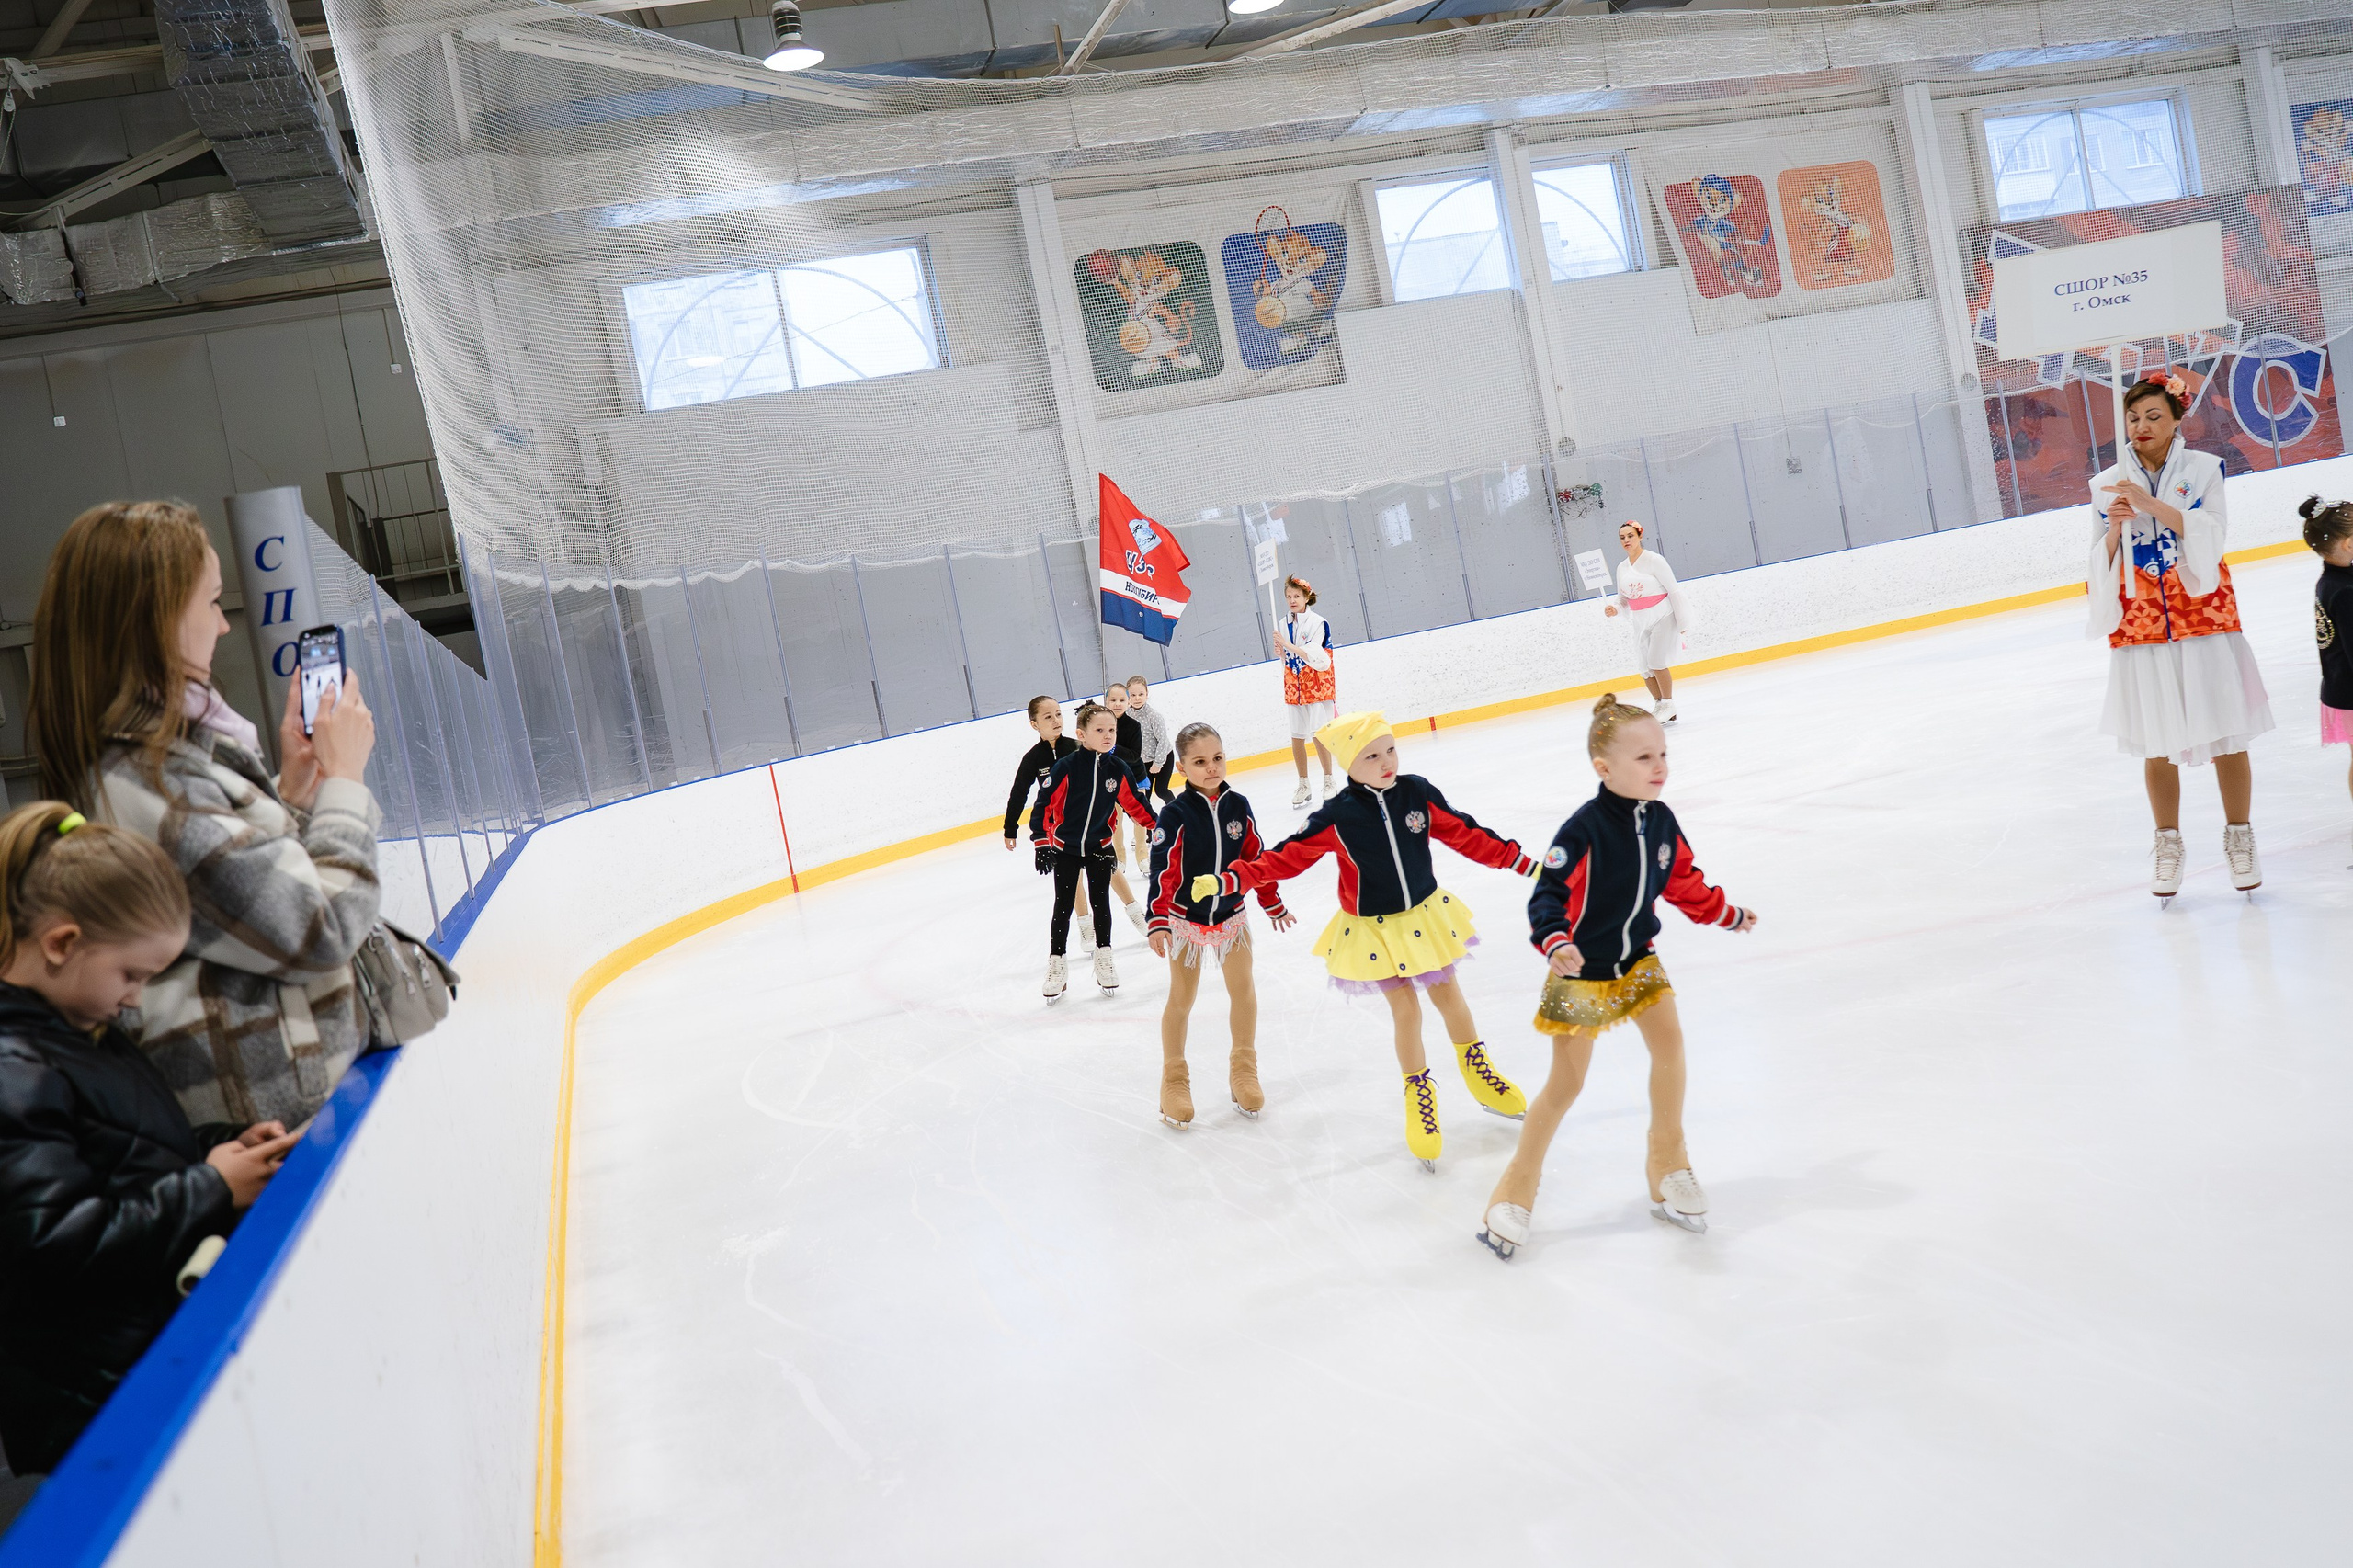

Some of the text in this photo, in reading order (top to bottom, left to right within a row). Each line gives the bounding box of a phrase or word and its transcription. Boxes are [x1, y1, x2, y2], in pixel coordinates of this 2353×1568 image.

[2054, 269, 2148, 296] СШОР №35
[2073, 293, 2131, 312] г. Омск
